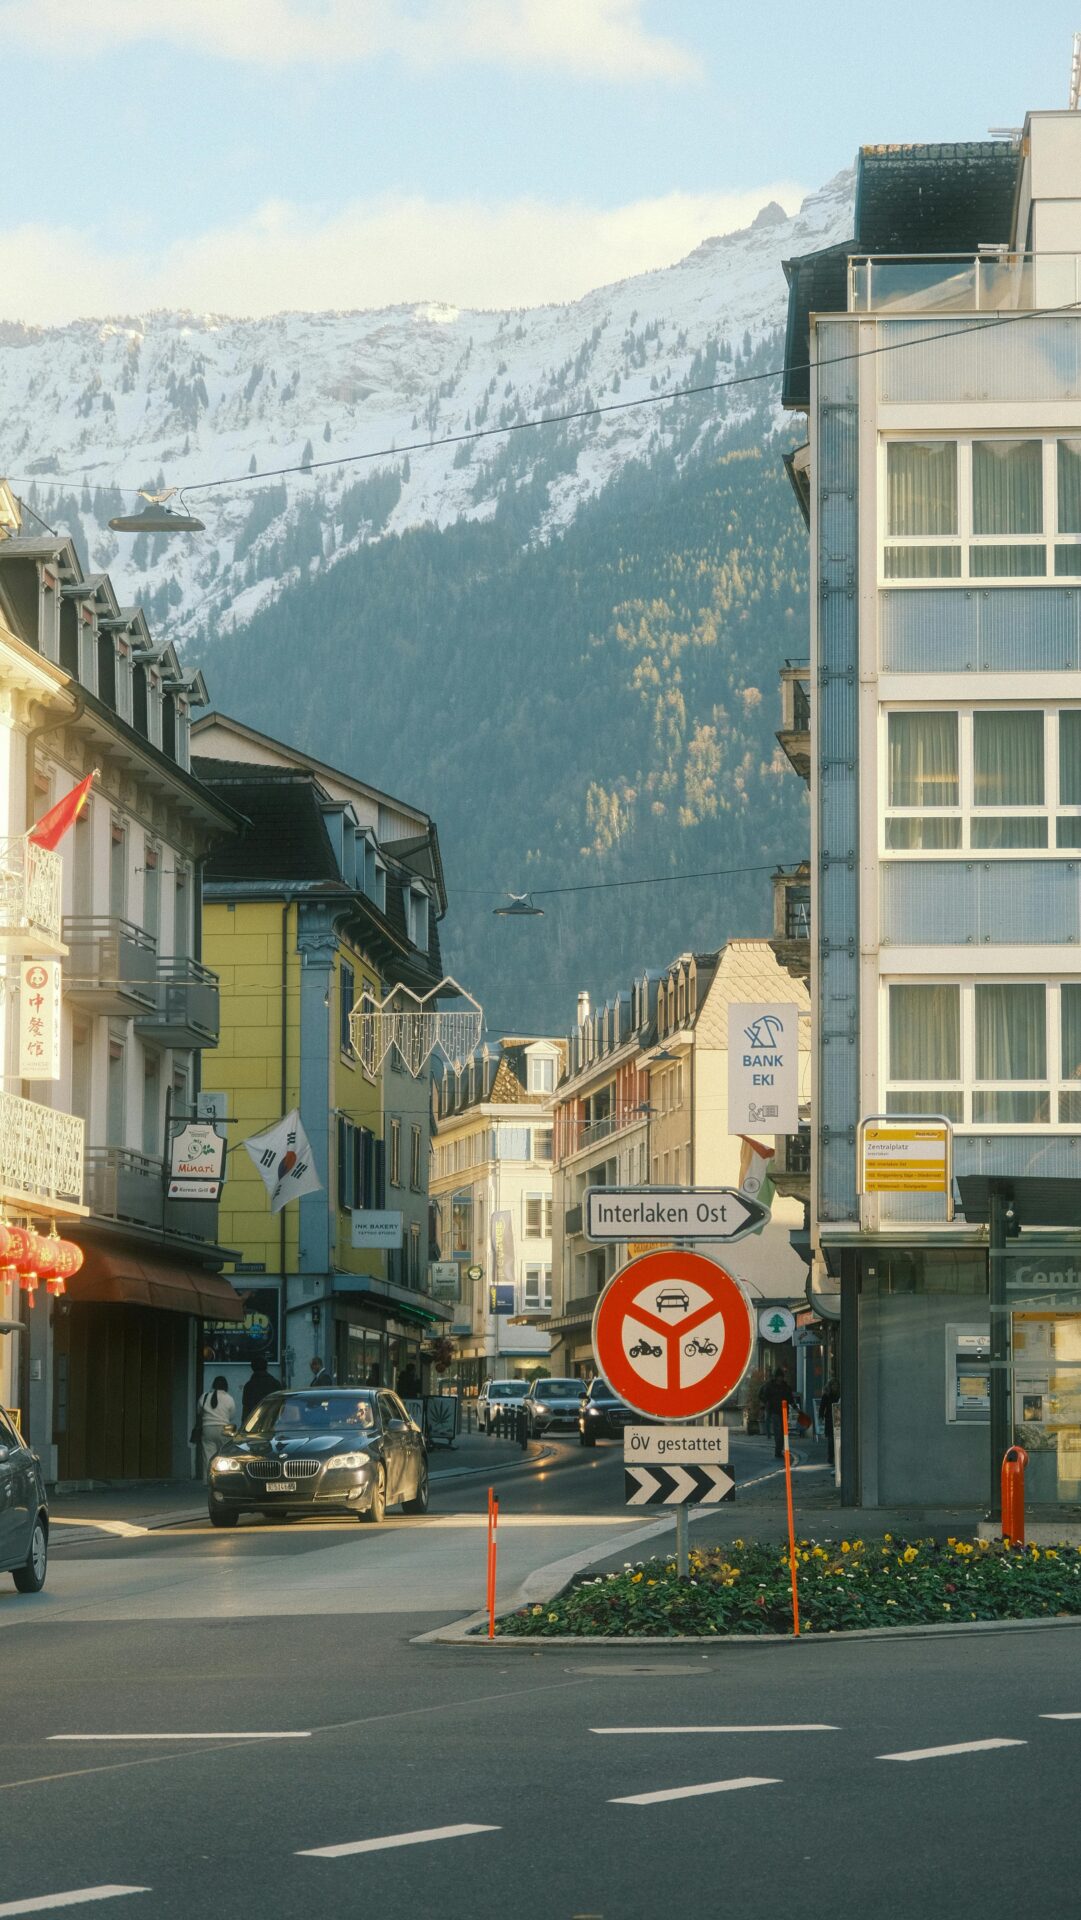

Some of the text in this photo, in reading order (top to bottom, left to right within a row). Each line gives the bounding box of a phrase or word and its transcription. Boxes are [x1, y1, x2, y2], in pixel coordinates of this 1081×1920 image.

[743, 1055, 783, 1067] BANK
[752, 1074, 774, 1086] EKI
[177, 1163, 215, 1174] Minari
[598, 1202, 727, 1223] Interlaken Ost
[1015, 1266, 1081, 1288] Cent
[630, 1433, 722, 1454] ÖV gestattet
